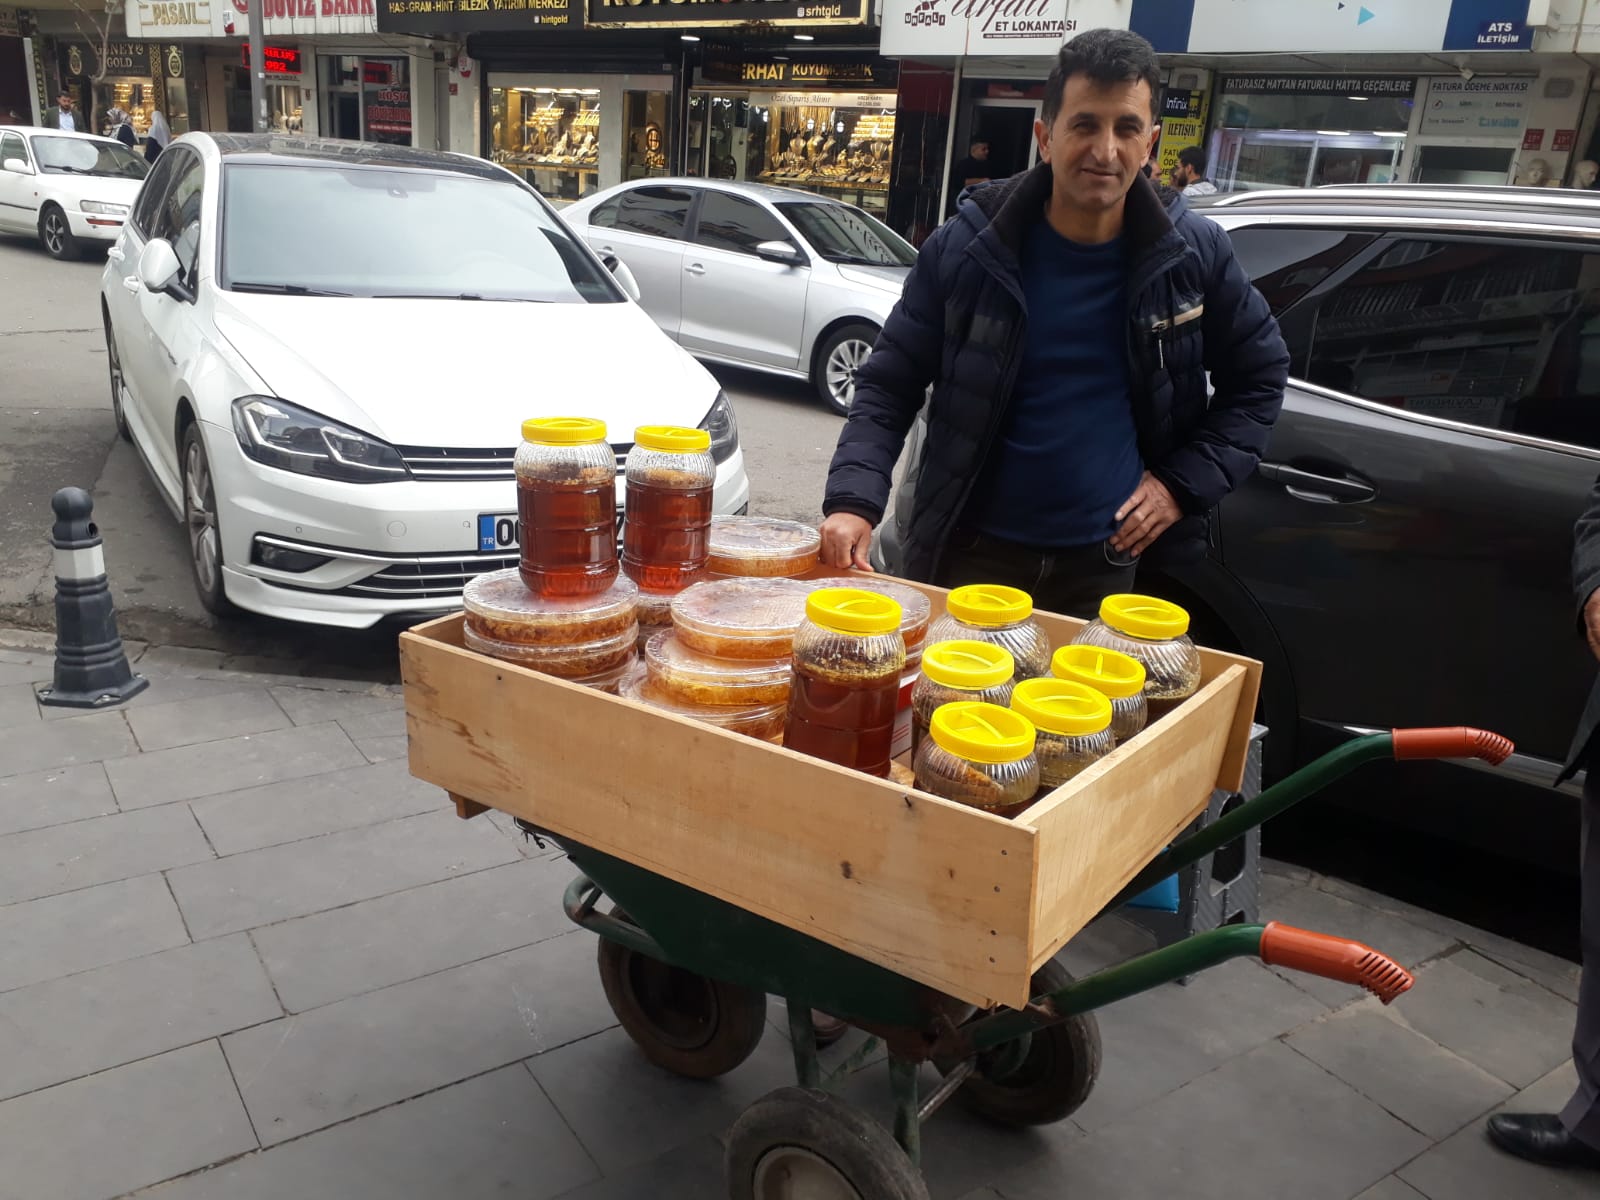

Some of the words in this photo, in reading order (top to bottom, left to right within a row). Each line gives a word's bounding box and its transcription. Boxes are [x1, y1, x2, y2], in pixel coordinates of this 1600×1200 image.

[995, 21, 1009, 31] ET
[1012, 20, 1077, 31] LOKANTASI
[1488, 22, 1513, 33] ATS
[106, 57, 133, 68] GOLD
[1226, 78, 1266, 89] FATURASIZ
[1297, 79, 1334, 90] FATURALI
[1362, 80, 1412, 93] GEÇENLERE
[1432, 82, 1462, 91] FATURA
[1166, 97, 1188, 110] Infinix
[483, 536, 495, 546] TR
